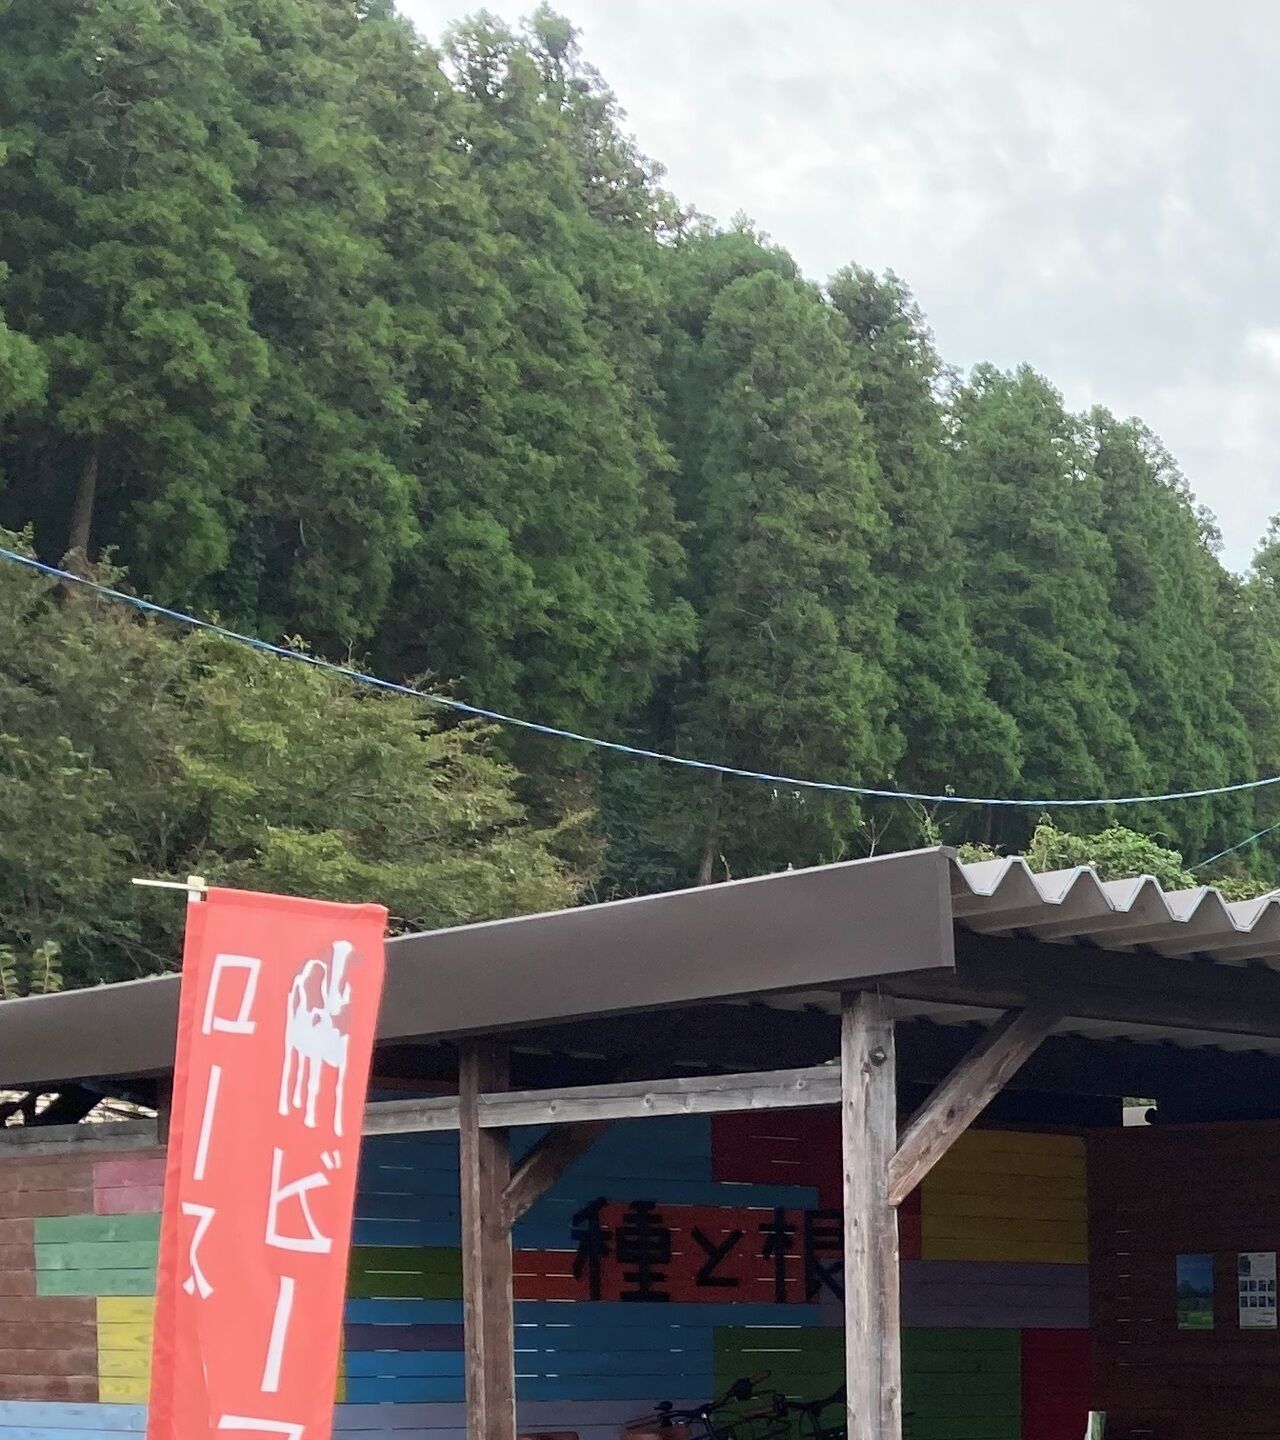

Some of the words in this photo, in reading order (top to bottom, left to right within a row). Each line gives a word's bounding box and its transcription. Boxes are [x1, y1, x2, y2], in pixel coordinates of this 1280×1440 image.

[182, 953, 262, 1300] ロース
[571, 1197, 844, 1304] 種と根
